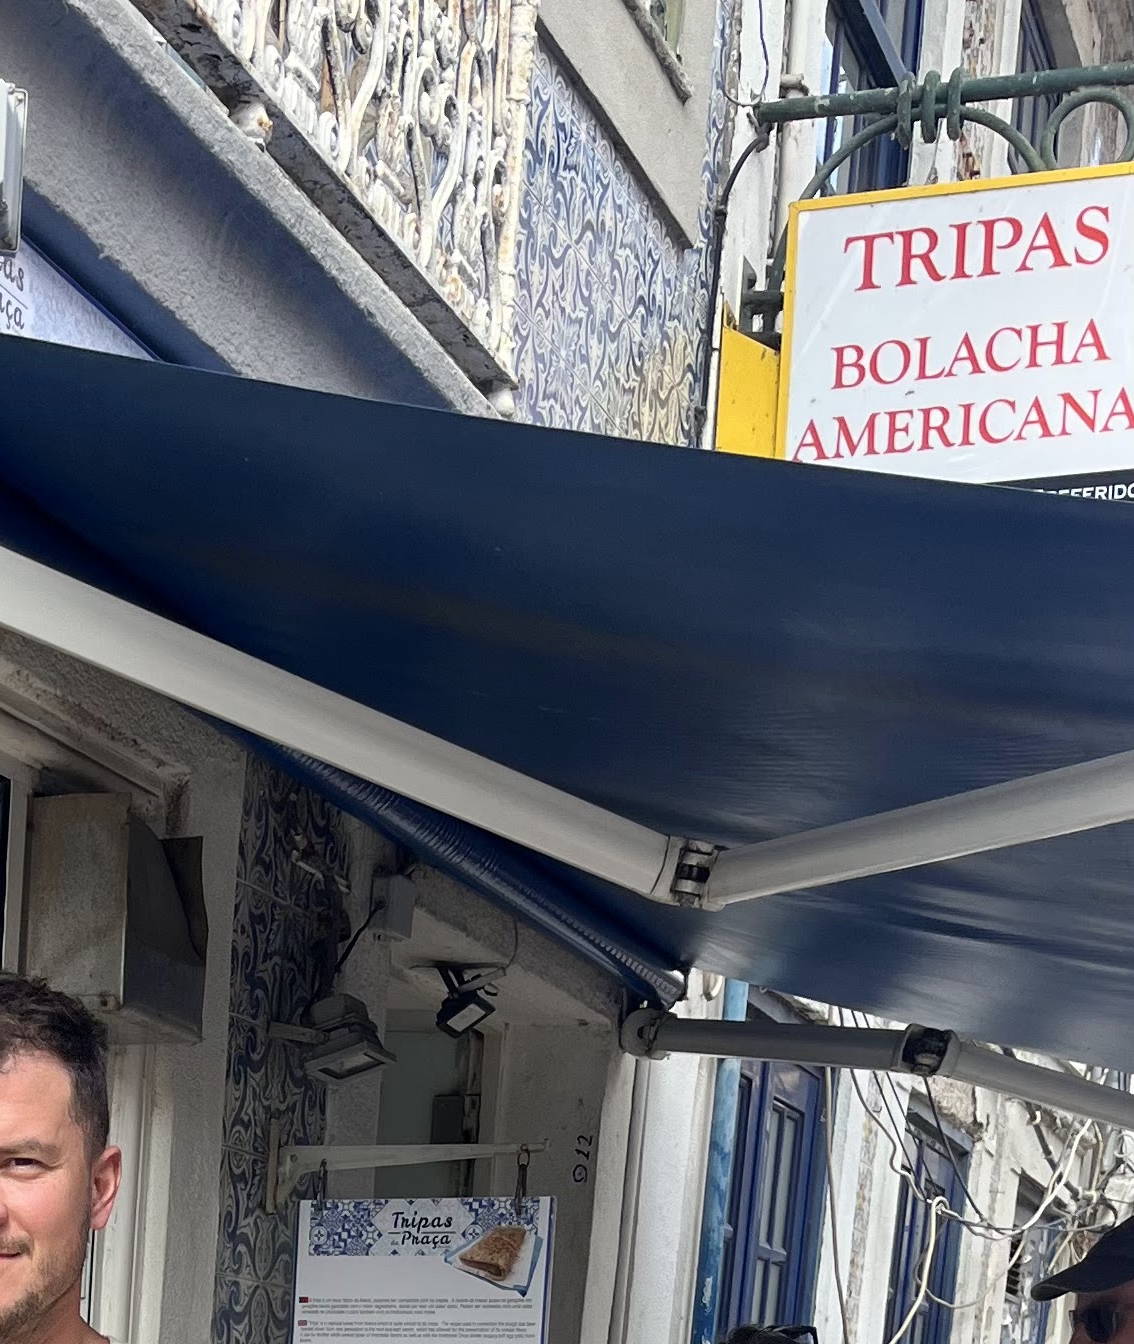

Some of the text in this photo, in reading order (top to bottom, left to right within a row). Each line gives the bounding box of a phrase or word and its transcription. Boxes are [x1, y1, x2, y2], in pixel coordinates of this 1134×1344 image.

[843, 205, 1110, 292] TRIPAS
[831, 317, 1111, 390] BOLACHA
[791, 387, 1134, 464] AMERICANA
[391, 1210, 453, 1234] Tripas
[401, 1230, 452, 1250] Praça
